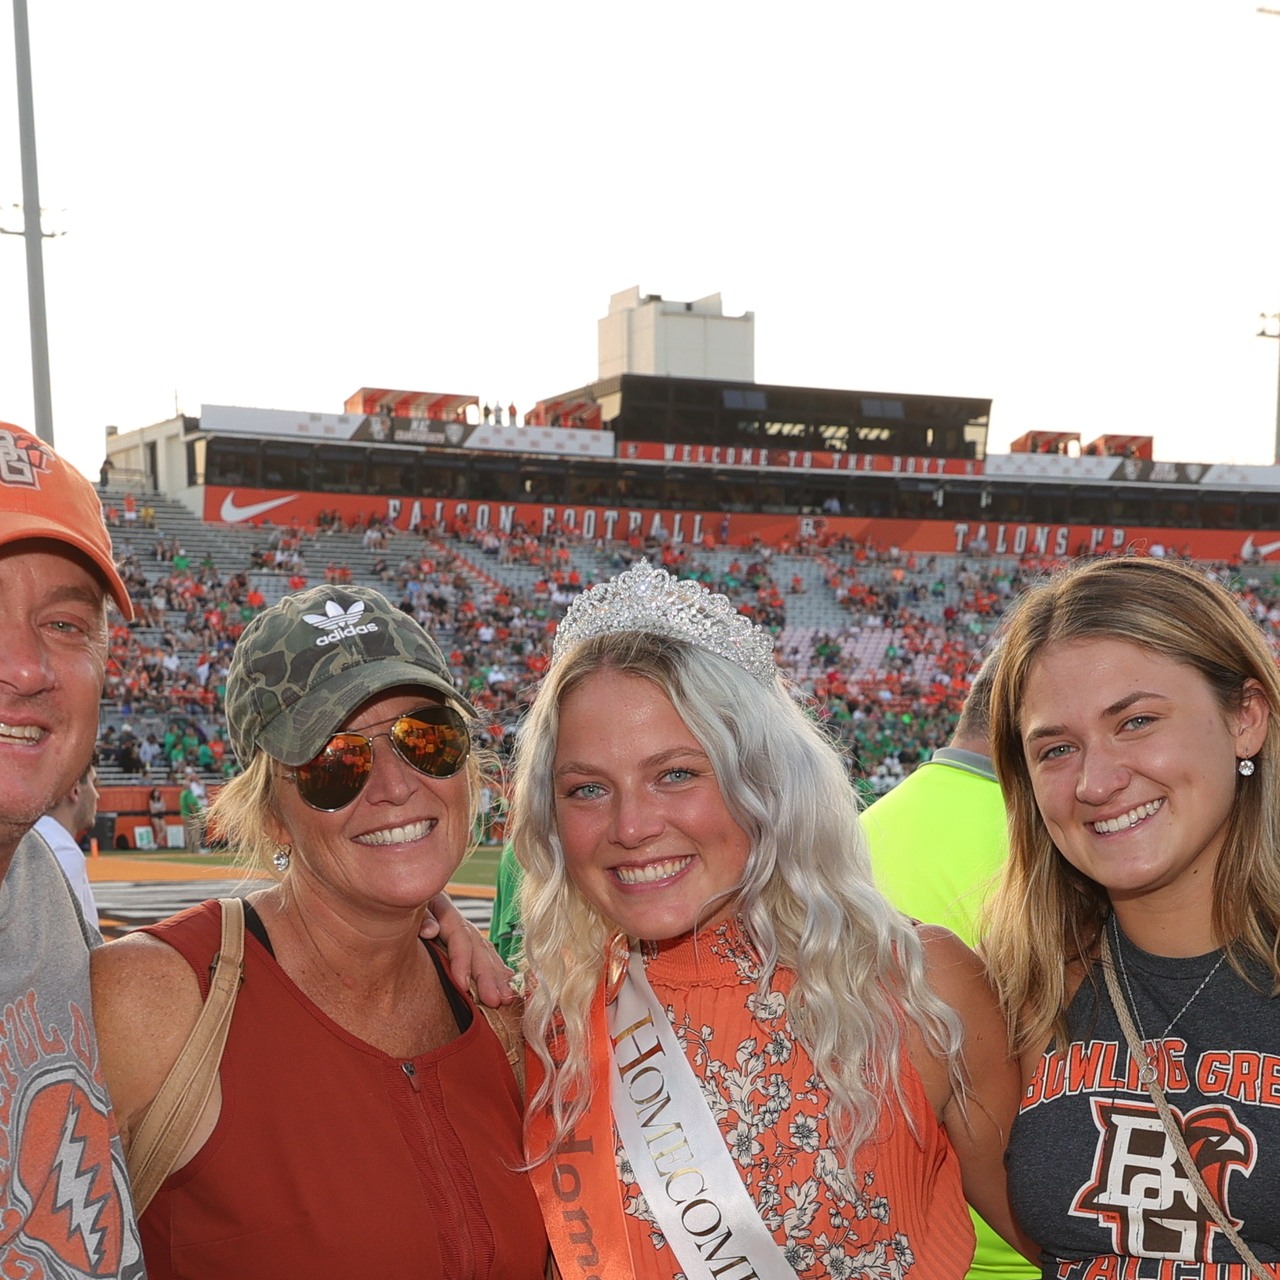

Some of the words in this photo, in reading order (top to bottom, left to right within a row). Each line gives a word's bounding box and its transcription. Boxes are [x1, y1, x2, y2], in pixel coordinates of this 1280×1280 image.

[664, 443, 768, 466] WELCOME
[788, 450, 813, 467] TO
[832, 452, 872, 471] THE
[892, 455, 946, 474] DOYT
[954, 522, 1068, 555] TALONS
[1090, 527, 1125, 554] UP
[316, 622, 379, 647] adidas
[1019, 1037, 1190, 1116] BOWLING
